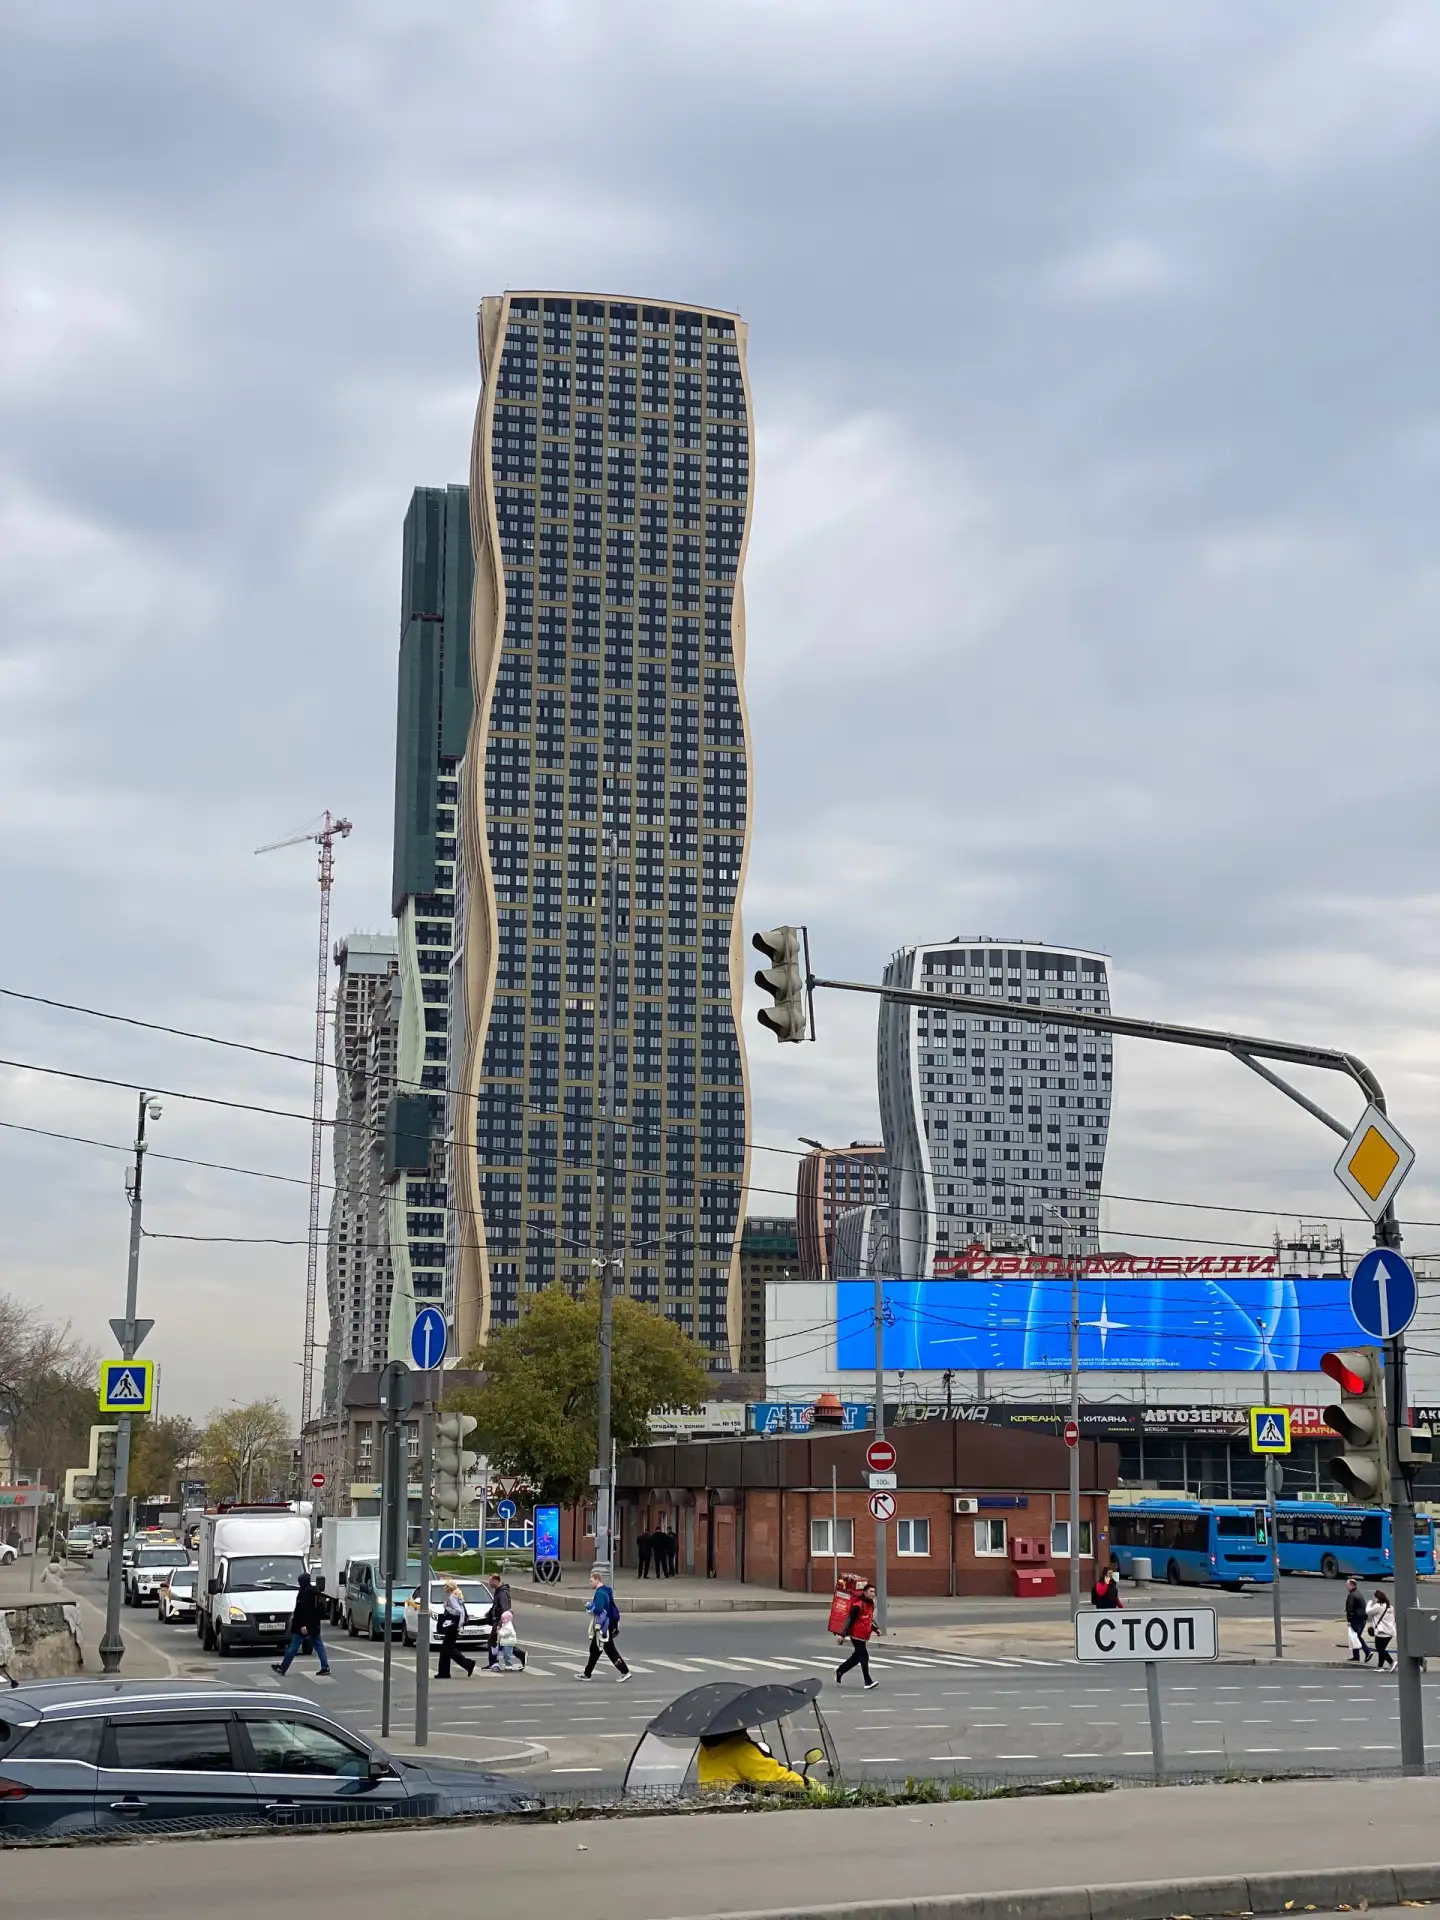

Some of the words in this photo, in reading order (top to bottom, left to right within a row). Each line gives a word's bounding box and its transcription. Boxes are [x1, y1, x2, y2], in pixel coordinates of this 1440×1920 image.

[651, 1406, 706, 1416] ШИТЕЛИ
[1083, 1415, 1128, 1423] КИТАЯНА
[1144, 1409, 1249, 1423] АВТОЗЕРКА
[1290, 1426, 1304, 1434] СЕ
[1305, 1426, 1338, 1434] ЗАПЧА
[1302, 1493, 1347, 1501] BEST
[1094, 1617, 1195, 1652] СТОП
